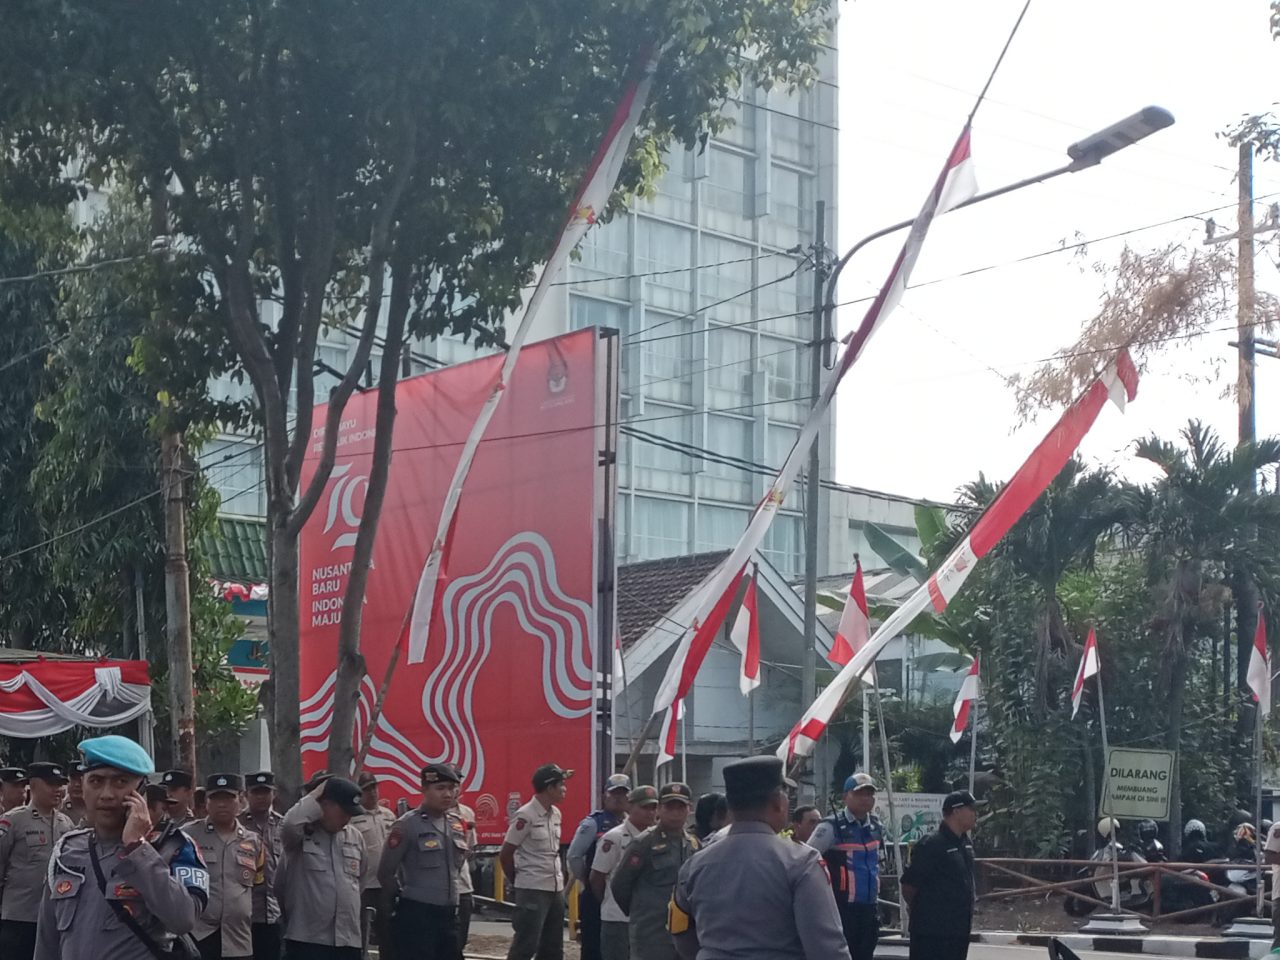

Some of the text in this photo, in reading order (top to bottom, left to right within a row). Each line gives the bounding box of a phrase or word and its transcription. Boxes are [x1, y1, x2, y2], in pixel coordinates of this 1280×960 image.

[313, 559, 375, 581] NUSANTA
[312, 579, 340, 595] BARU
[312, 594, 368, 613] INDONA
[312, 611, 342, 627] MAJU
[1110, 768, 1168, 781] DILARANG
[1117, 785, 1158, 794] MEMBUANG
[176, 866, 208, 890] PR
